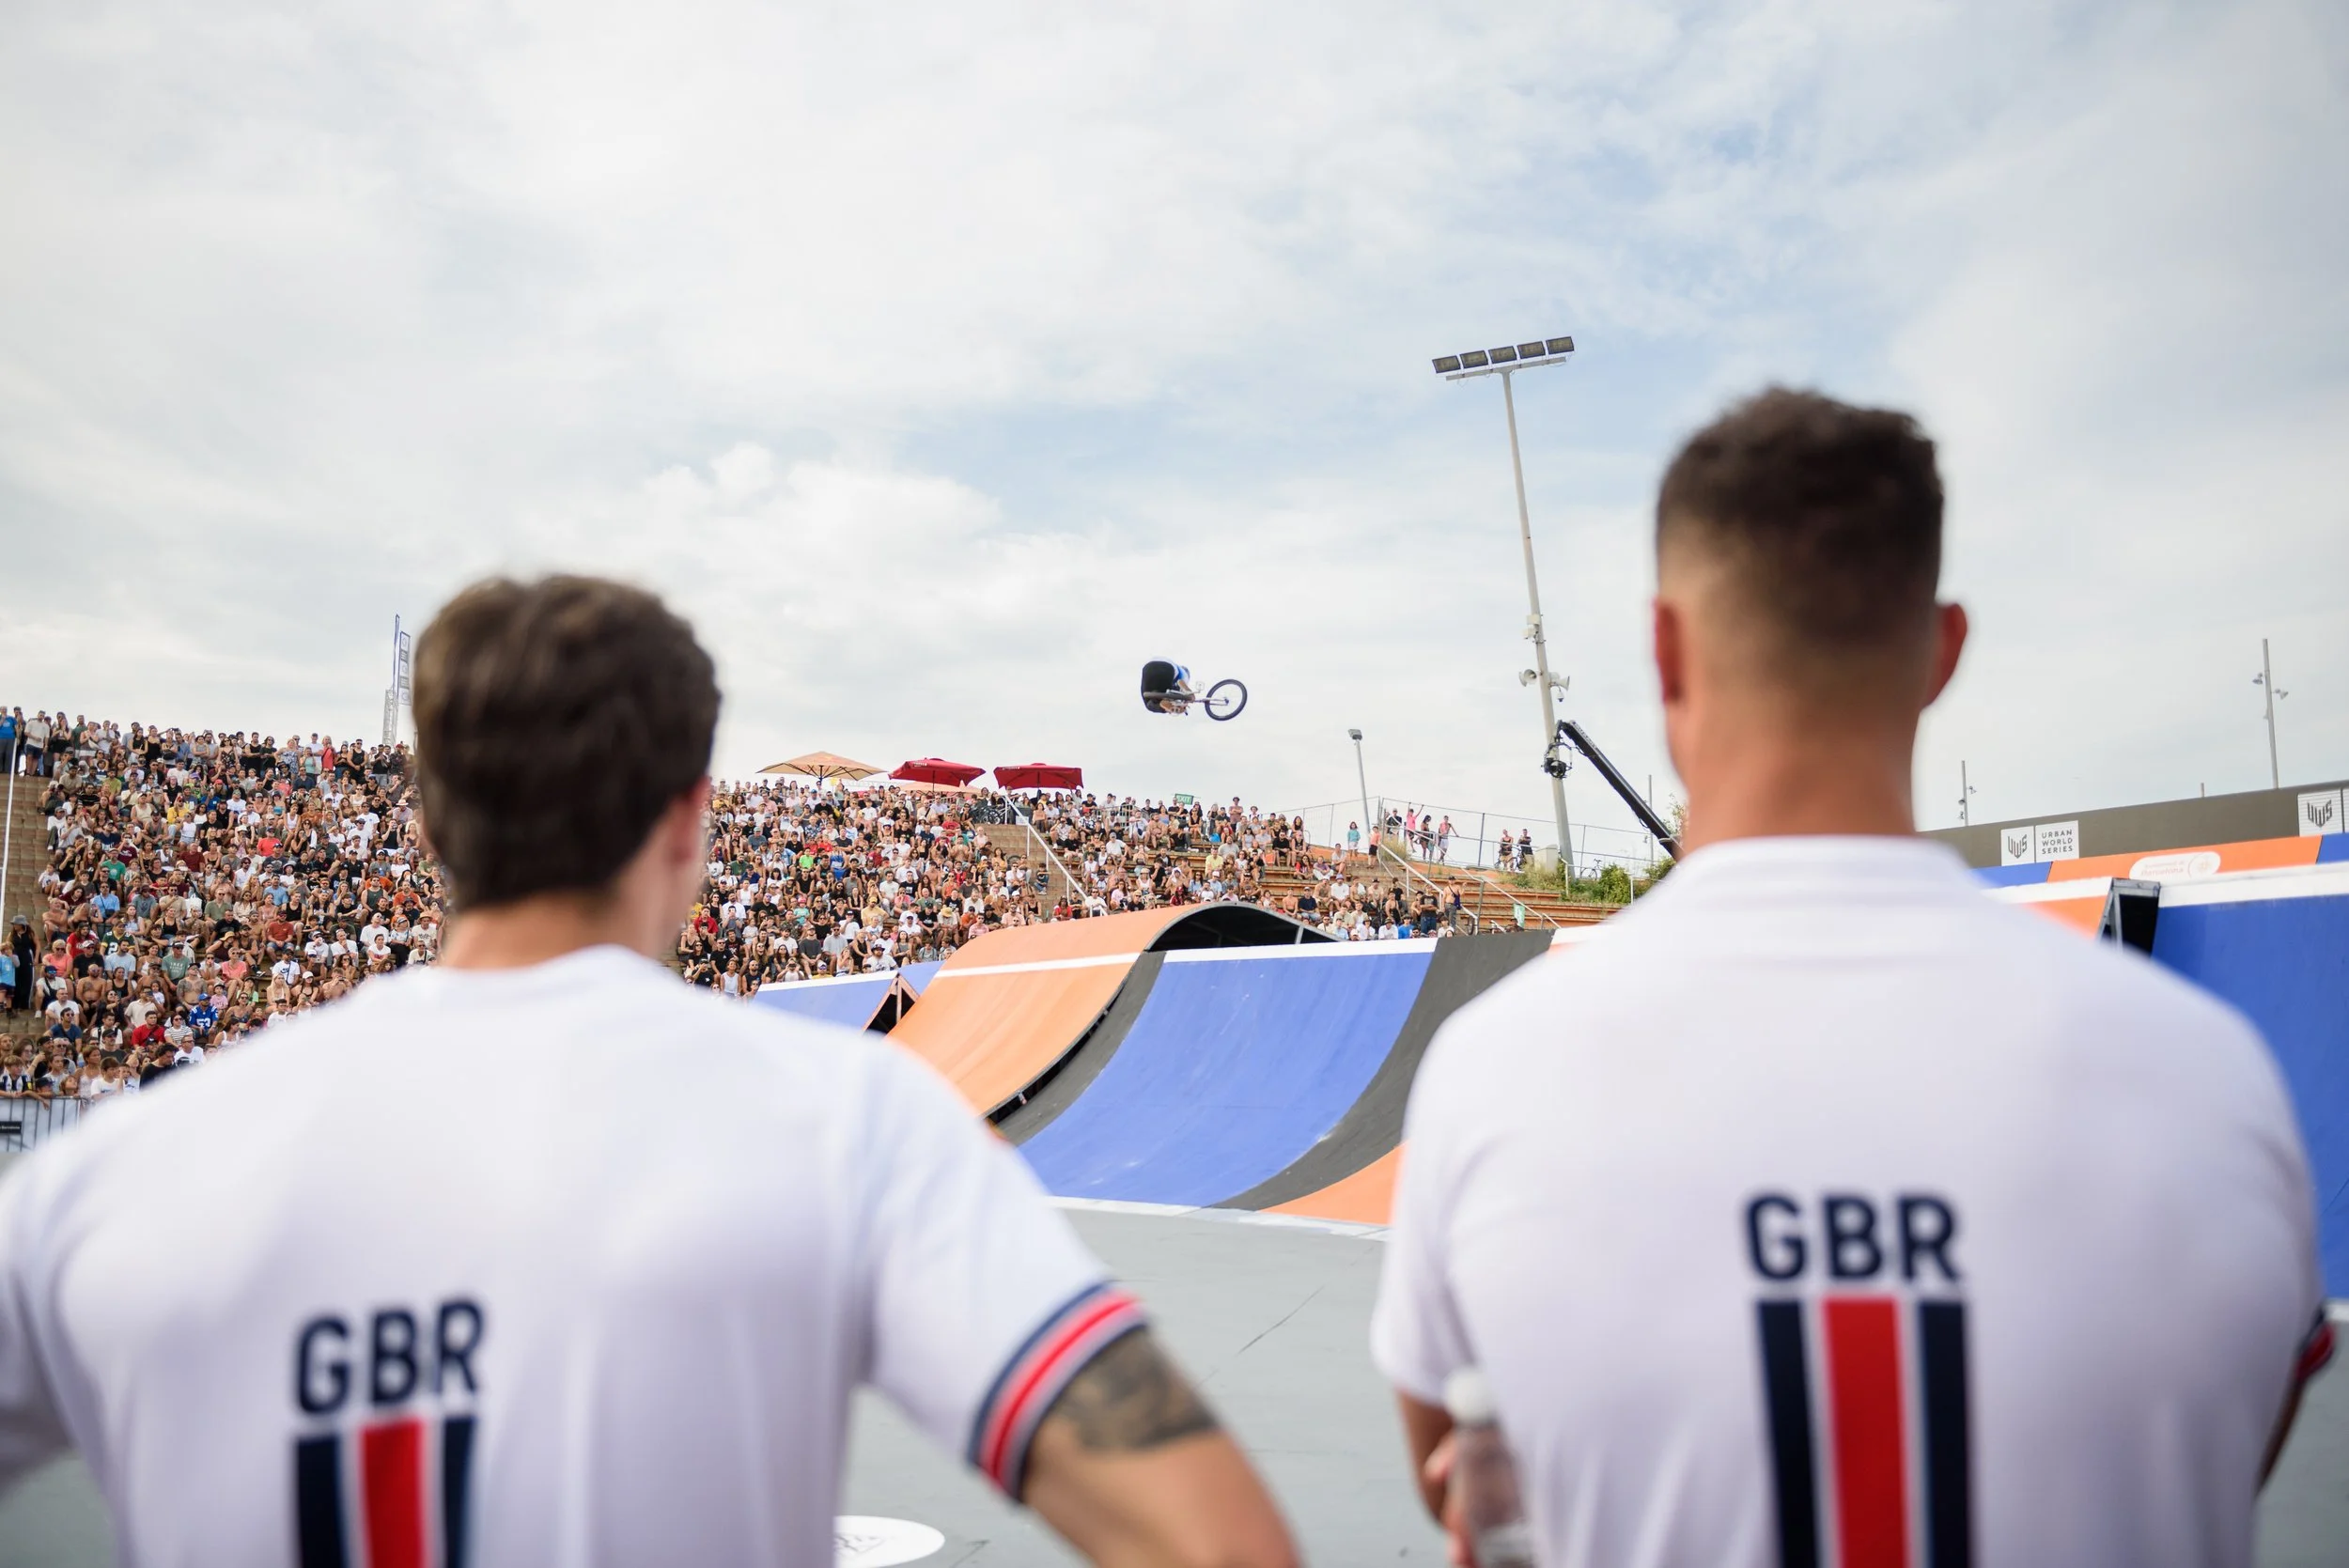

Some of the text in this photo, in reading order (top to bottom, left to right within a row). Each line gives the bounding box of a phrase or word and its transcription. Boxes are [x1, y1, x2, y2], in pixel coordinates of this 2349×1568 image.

[2042, 829, 2073, 839] URBAN
[2042, 837, 2073, 846] WORLD
[2042, 846, 2073, 855] SERIES
[1744, 1192, 1962, 1282] GBR
[296, 1297, 486, 1416] GBR
